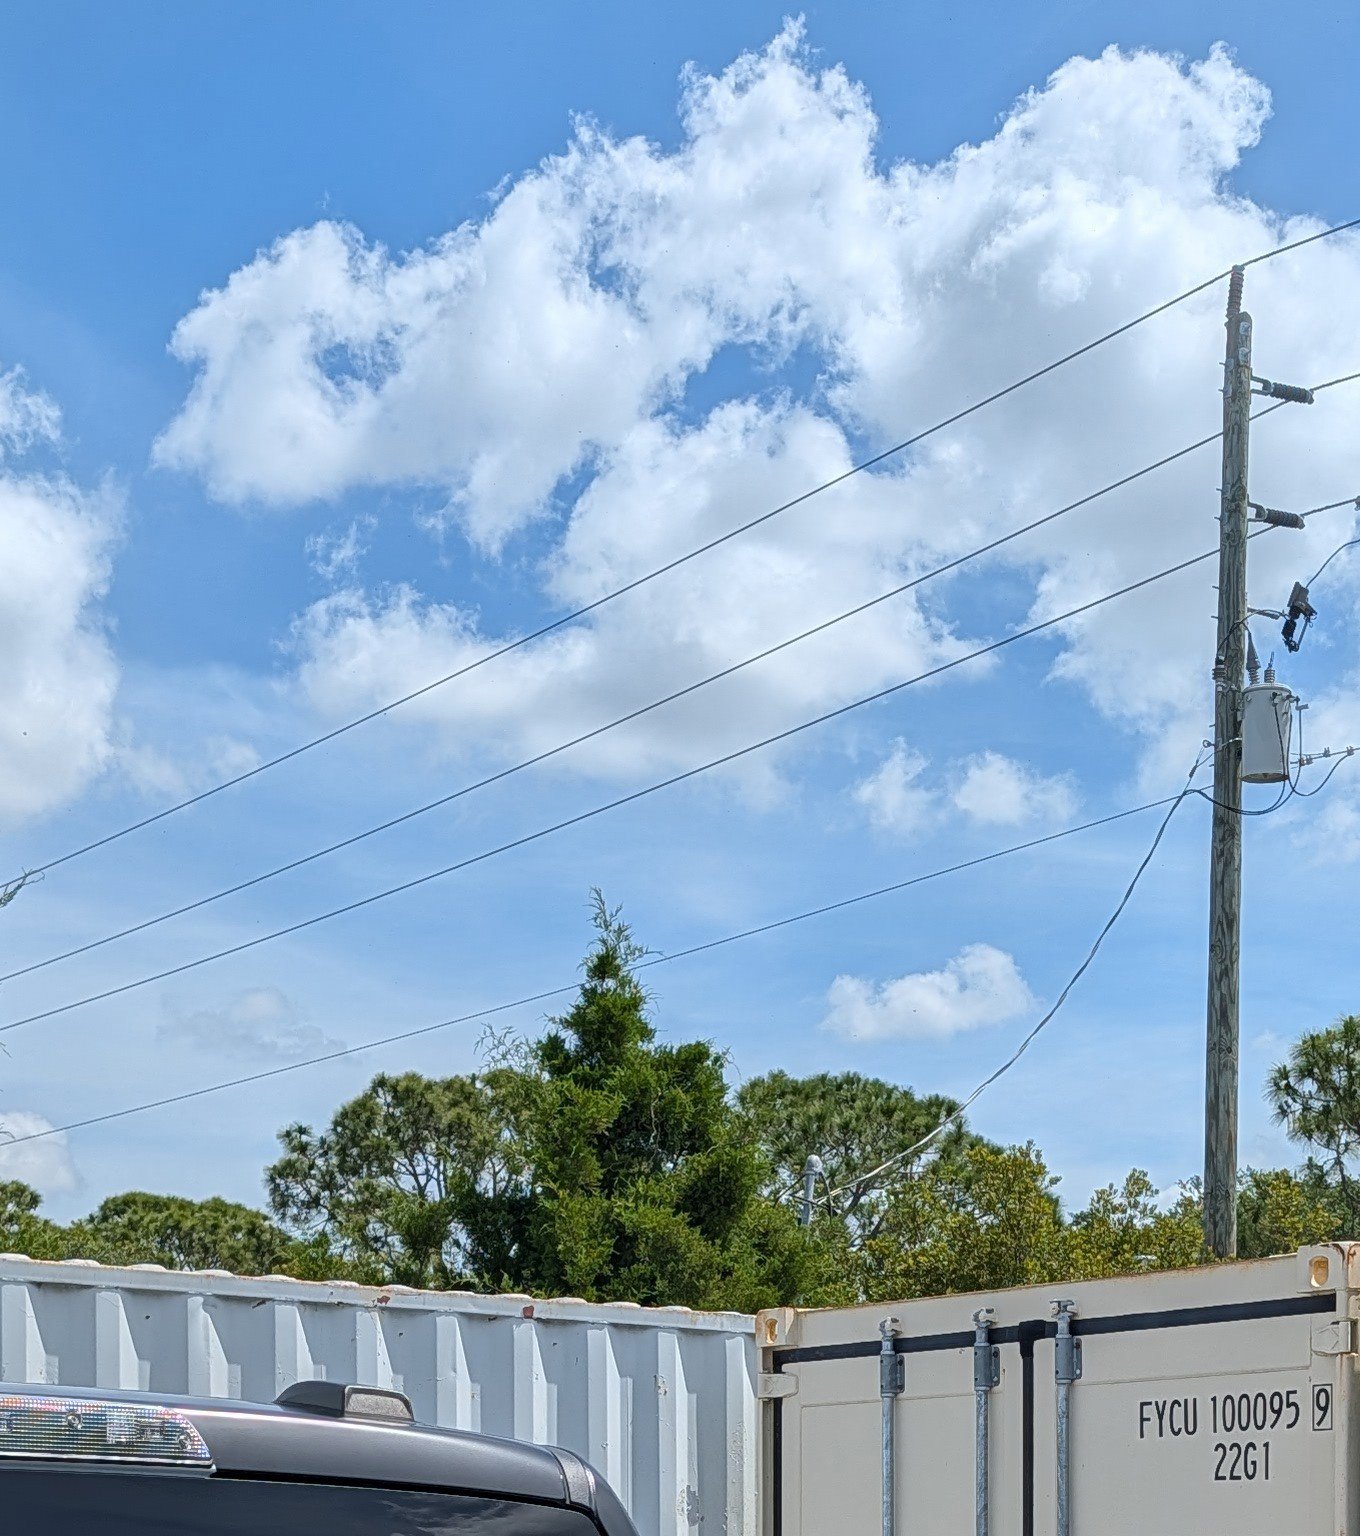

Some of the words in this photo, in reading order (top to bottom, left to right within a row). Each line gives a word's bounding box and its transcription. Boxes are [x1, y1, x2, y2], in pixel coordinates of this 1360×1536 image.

[1139, 1398, 1198, 1438] FYCU
[1210, 1390, 1300, 1434] 100095
[1314, 1386, 1332, 1430] 9
[1214, 1441, 1270, 1481] 22G1
